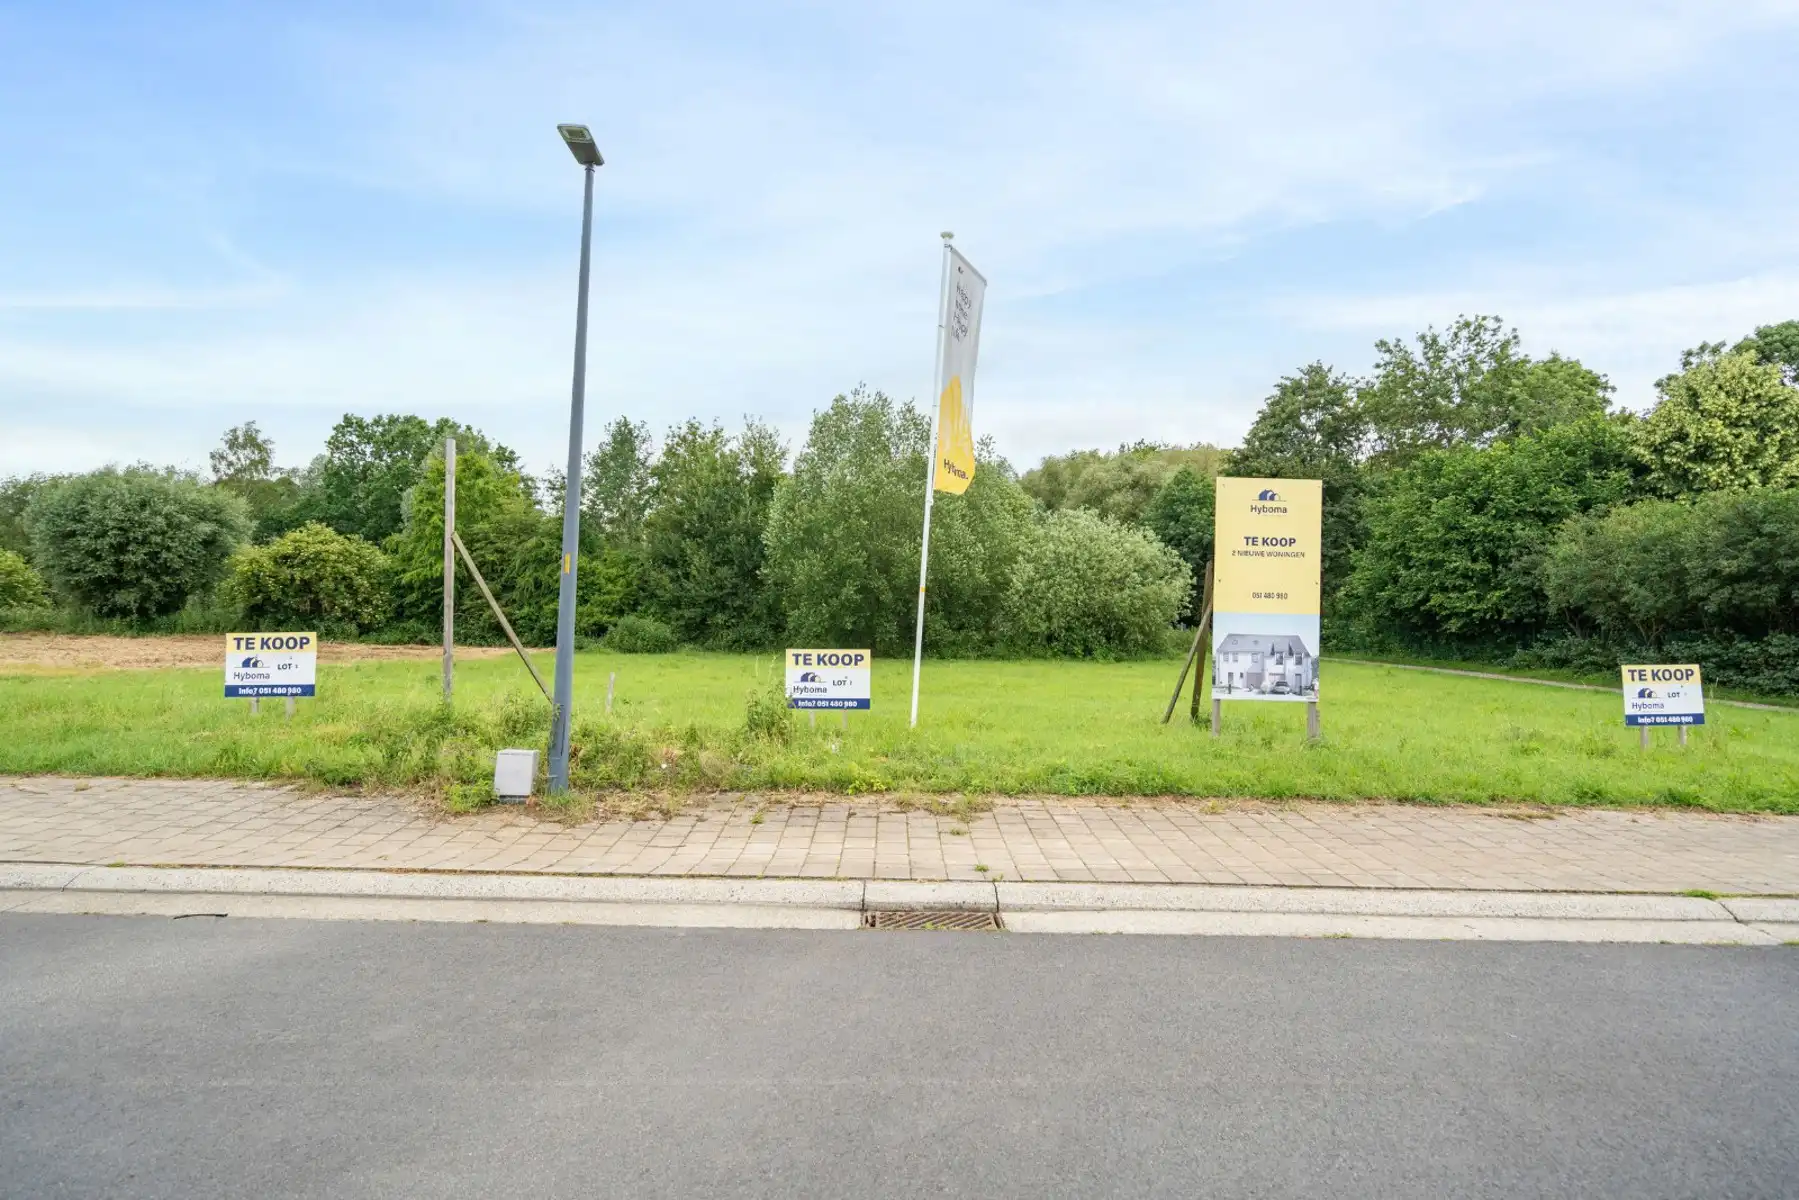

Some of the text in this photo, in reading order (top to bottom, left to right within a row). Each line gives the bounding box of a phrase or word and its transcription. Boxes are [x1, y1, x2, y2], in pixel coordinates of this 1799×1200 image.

[1250, 504, 1288, 515] Hyboma
[1243, 536, 1297, 547] TE KOOP
[1237, 550, 1265, 558] NIEUWE
[1266, 550, 1305, 558] WONINGEN
[233, 636, 310, 650] TE KOOP
[792, 653, 864, 666] TE KOOP
[233, 671, 271, 681] Hyboma
[1627, 668, 1694, 682] TE KOOP
[238, 687, 257, 695] Info?
[287, 687, 302, 695] 980
[793, 685, 828, 694] Hyboma
[844, 700, 858, 708] 980
[1631, 702, 1665, 711] Hyboma
